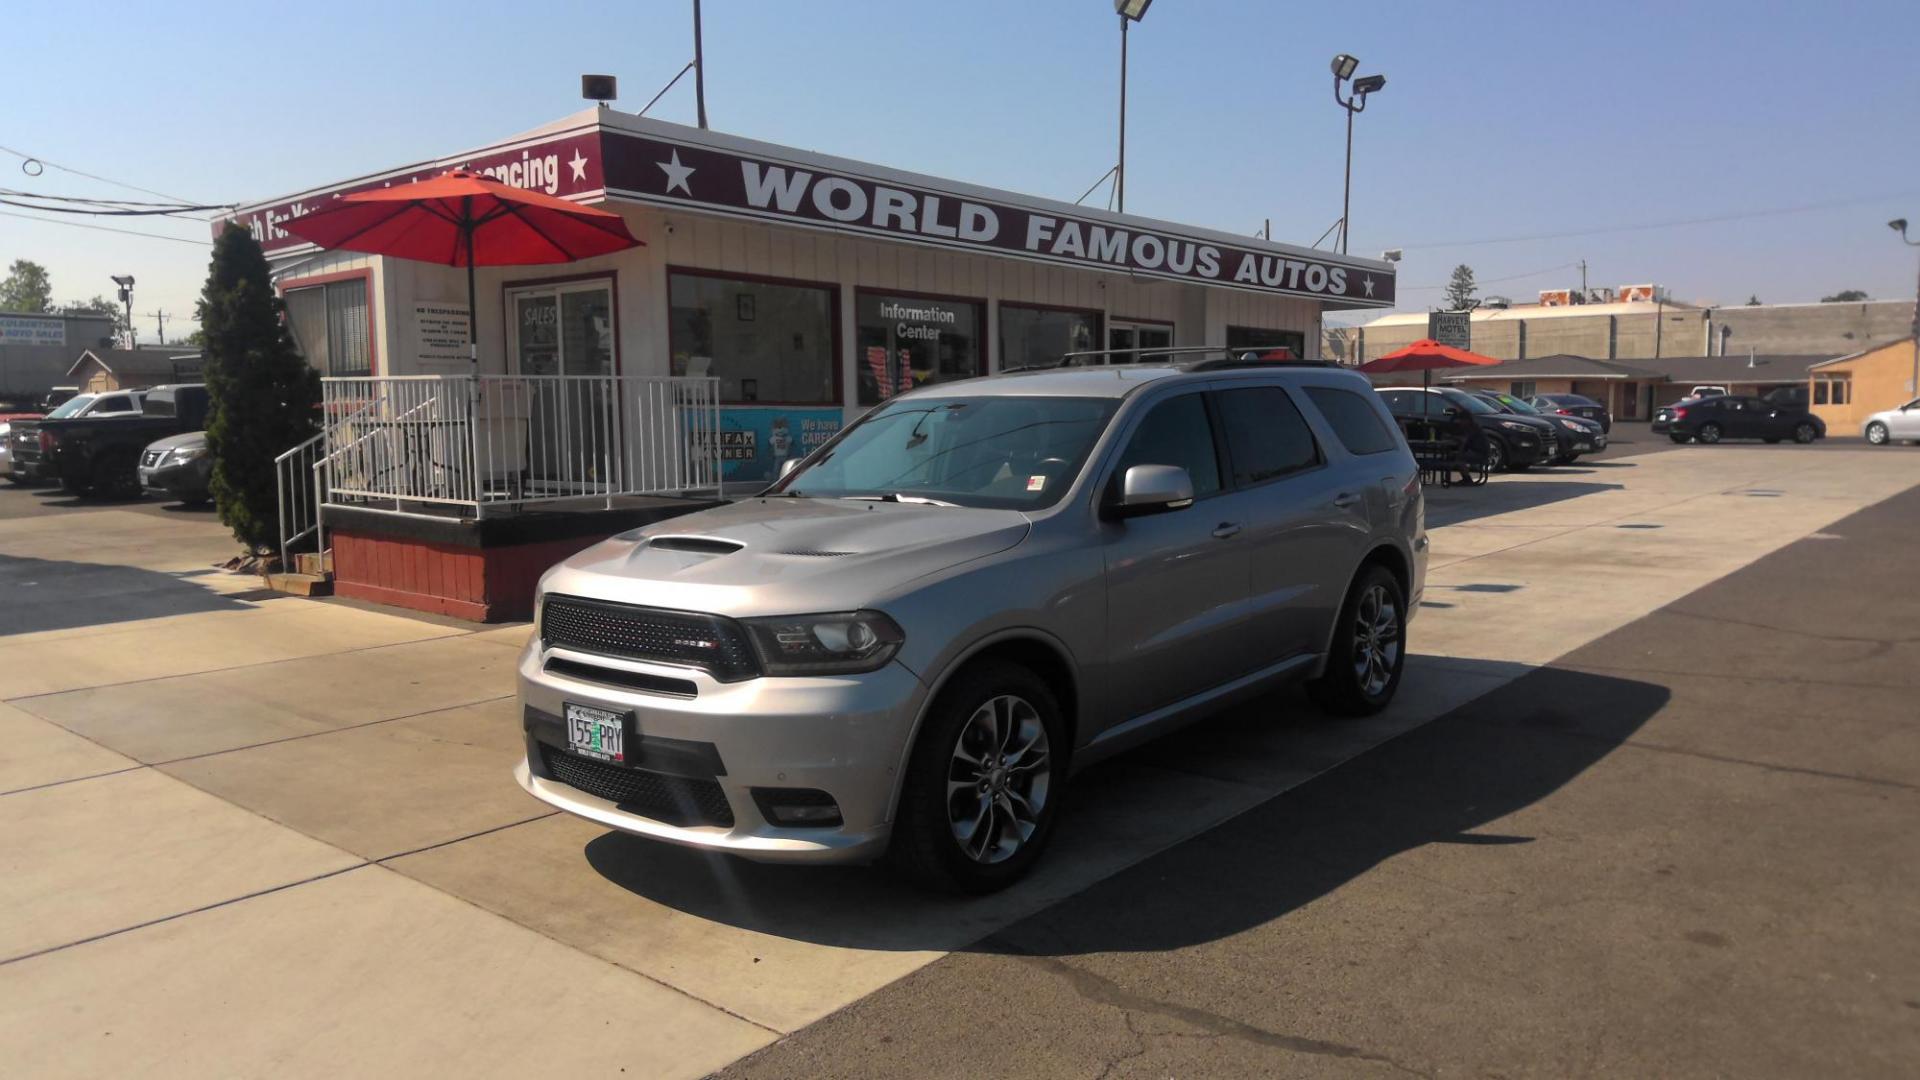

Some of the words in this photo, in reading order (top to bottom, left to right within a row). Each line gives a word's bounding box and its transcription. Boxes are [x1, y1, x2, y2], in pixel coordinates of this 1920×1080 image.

[741, 160, 1000, 242] WORLD
[1025, 215, 1221, 279] FAMOUS
[1234, 254, 1348, 295] AUTOS
[880, 303, 955, 323] Information
[896, 322, 941, 340] Center
[801, 418, 816, 430] We
[569, 718, 592, 745] 155
[599, 723, 623, 753] PRY
